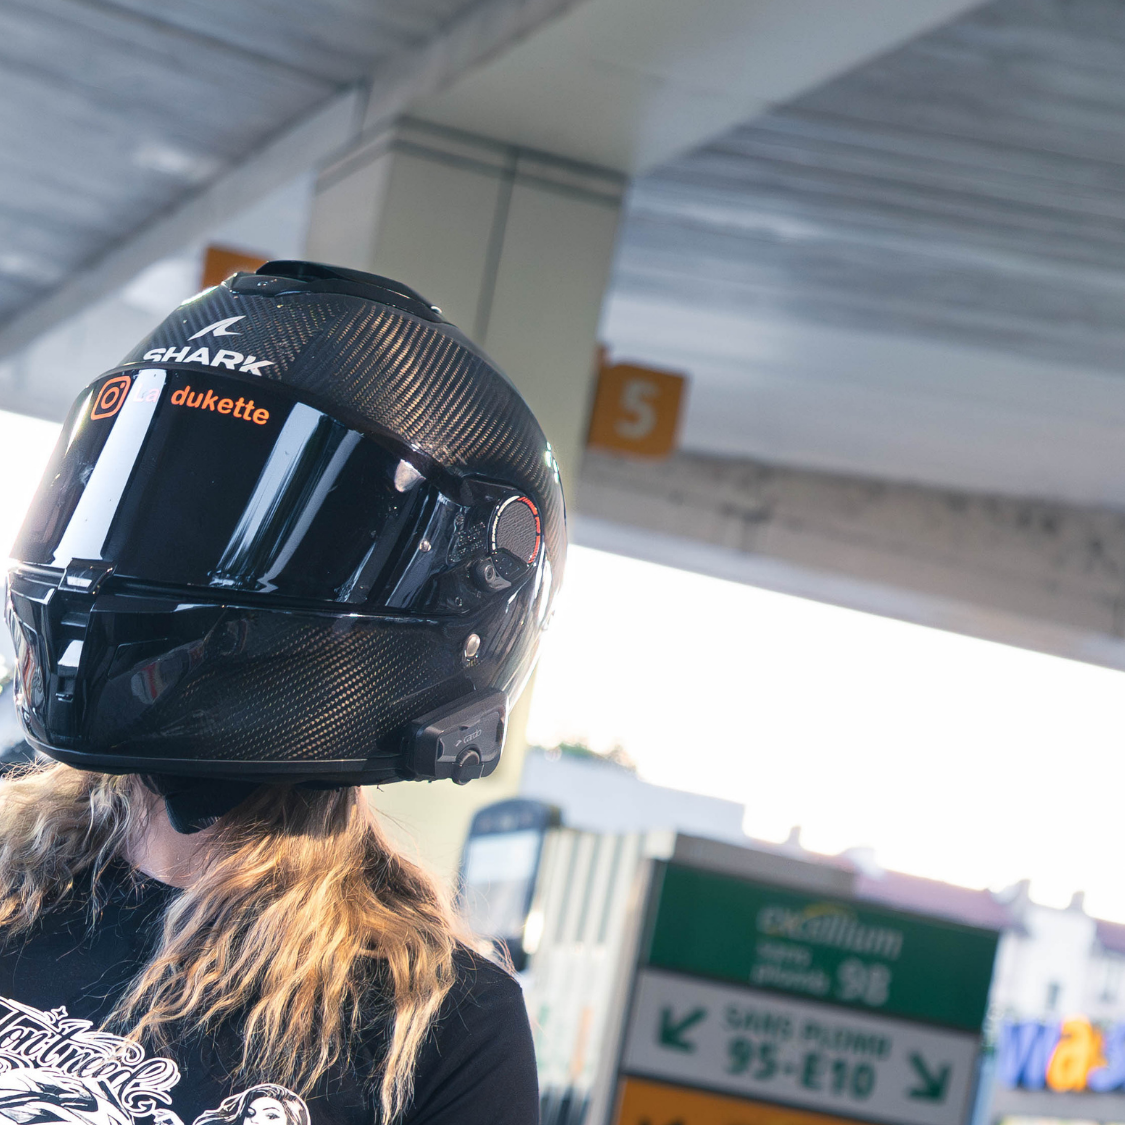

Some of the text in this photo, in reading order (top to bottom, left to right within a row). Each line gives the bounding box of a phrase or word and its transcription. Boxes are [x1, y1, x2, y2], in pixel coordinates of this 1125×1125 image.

[143, 346, 275, 377] SHARK
[171, 385, 270, 426] dukette
[614, 378, 661, 440] 5
[837, 956, 891, 1006] 98
[723, 1003, 892, 1058] SANS PLOMB
[726, 1035, 878, 1100] 95-E10
